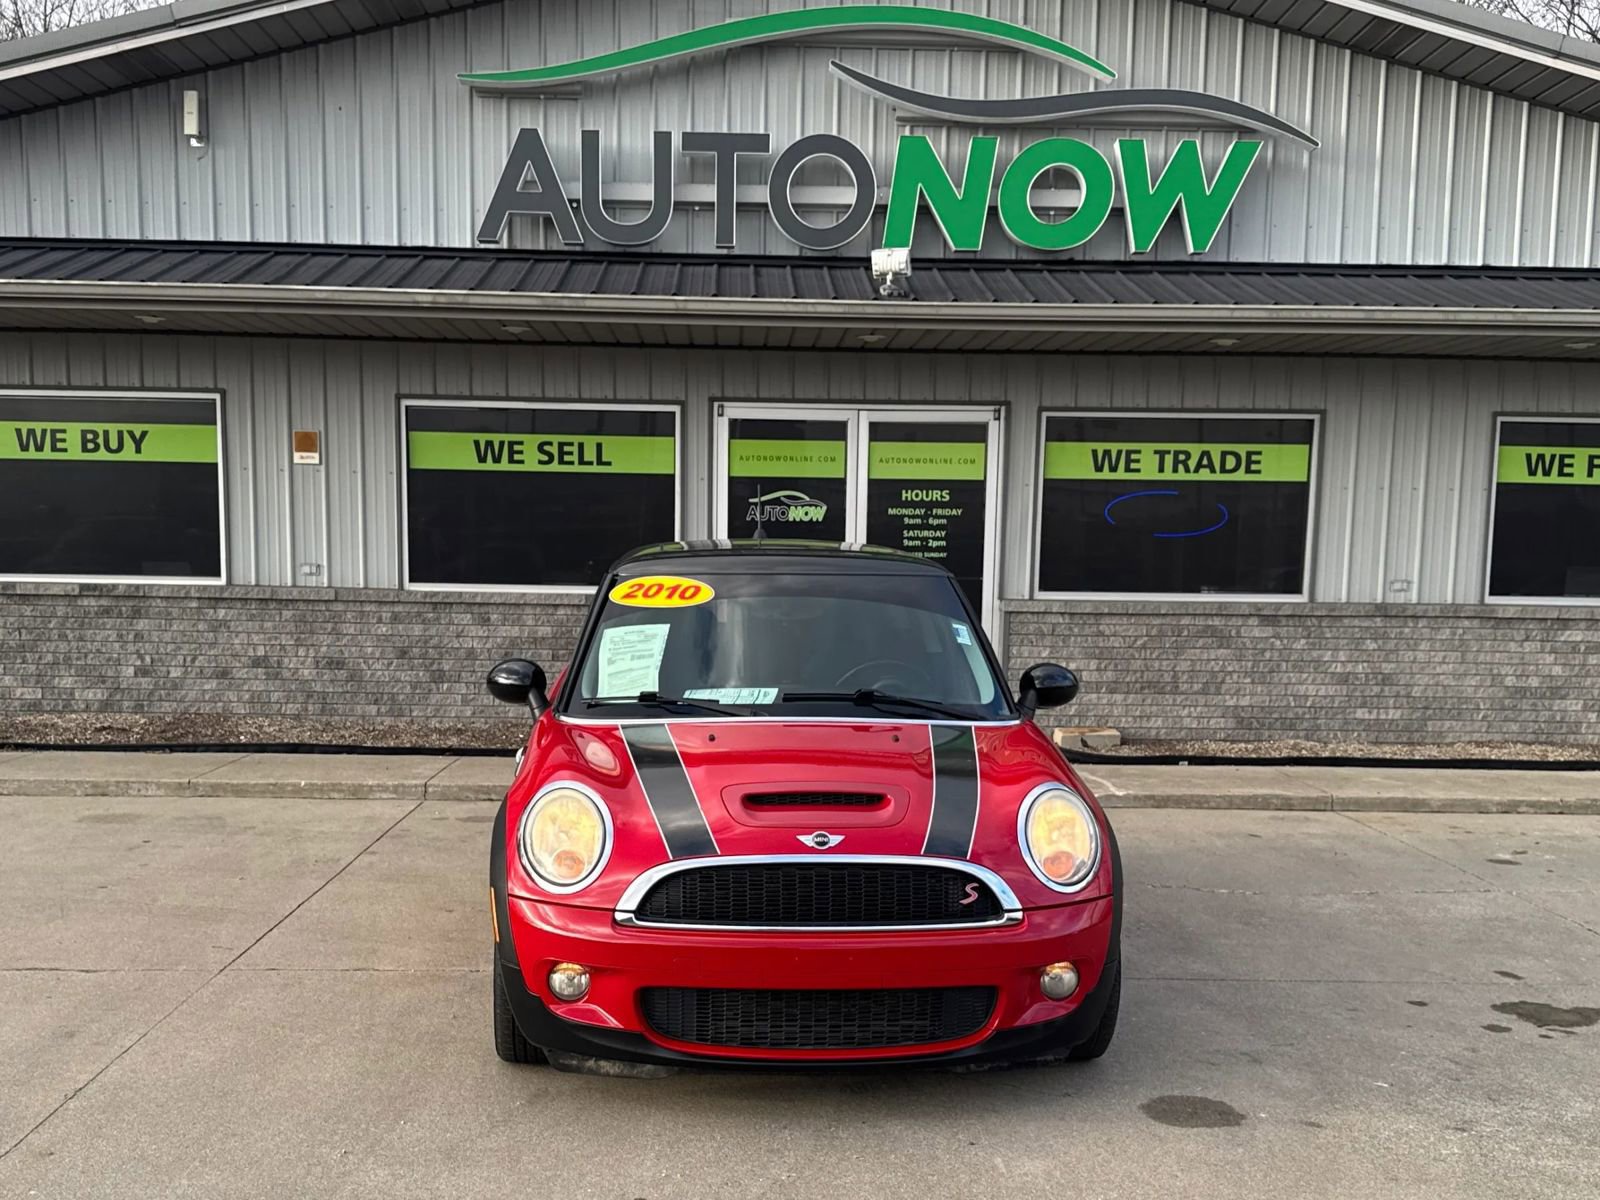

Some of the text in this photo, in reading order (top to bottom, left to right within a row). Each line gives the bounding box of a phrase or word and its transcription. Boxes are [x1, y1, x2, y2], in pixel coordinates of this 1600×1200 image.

[15, 428, 149, 455] WE BUY
[473, 440, 612, 466] WE SELL
[739, 455, 837, 463] AUTONOWONLINE.COM
[879, 457, 976, 466] AUTONOWONLINE.COM
[1091, 449, 1262, 475] WE TRADE
[1525, 453, 1575, 477] WE
[901, 489, 950, 501] HOURS
[932, 508, 963, 516] FRIDAY
[903, 517, 921, 525] 9am
[928, 517, 947, 526] 6pm
[927, 539, 947, 548] 2pm
[620, 583, 701, 600] 2010
[959, 882, 979, 905] S
